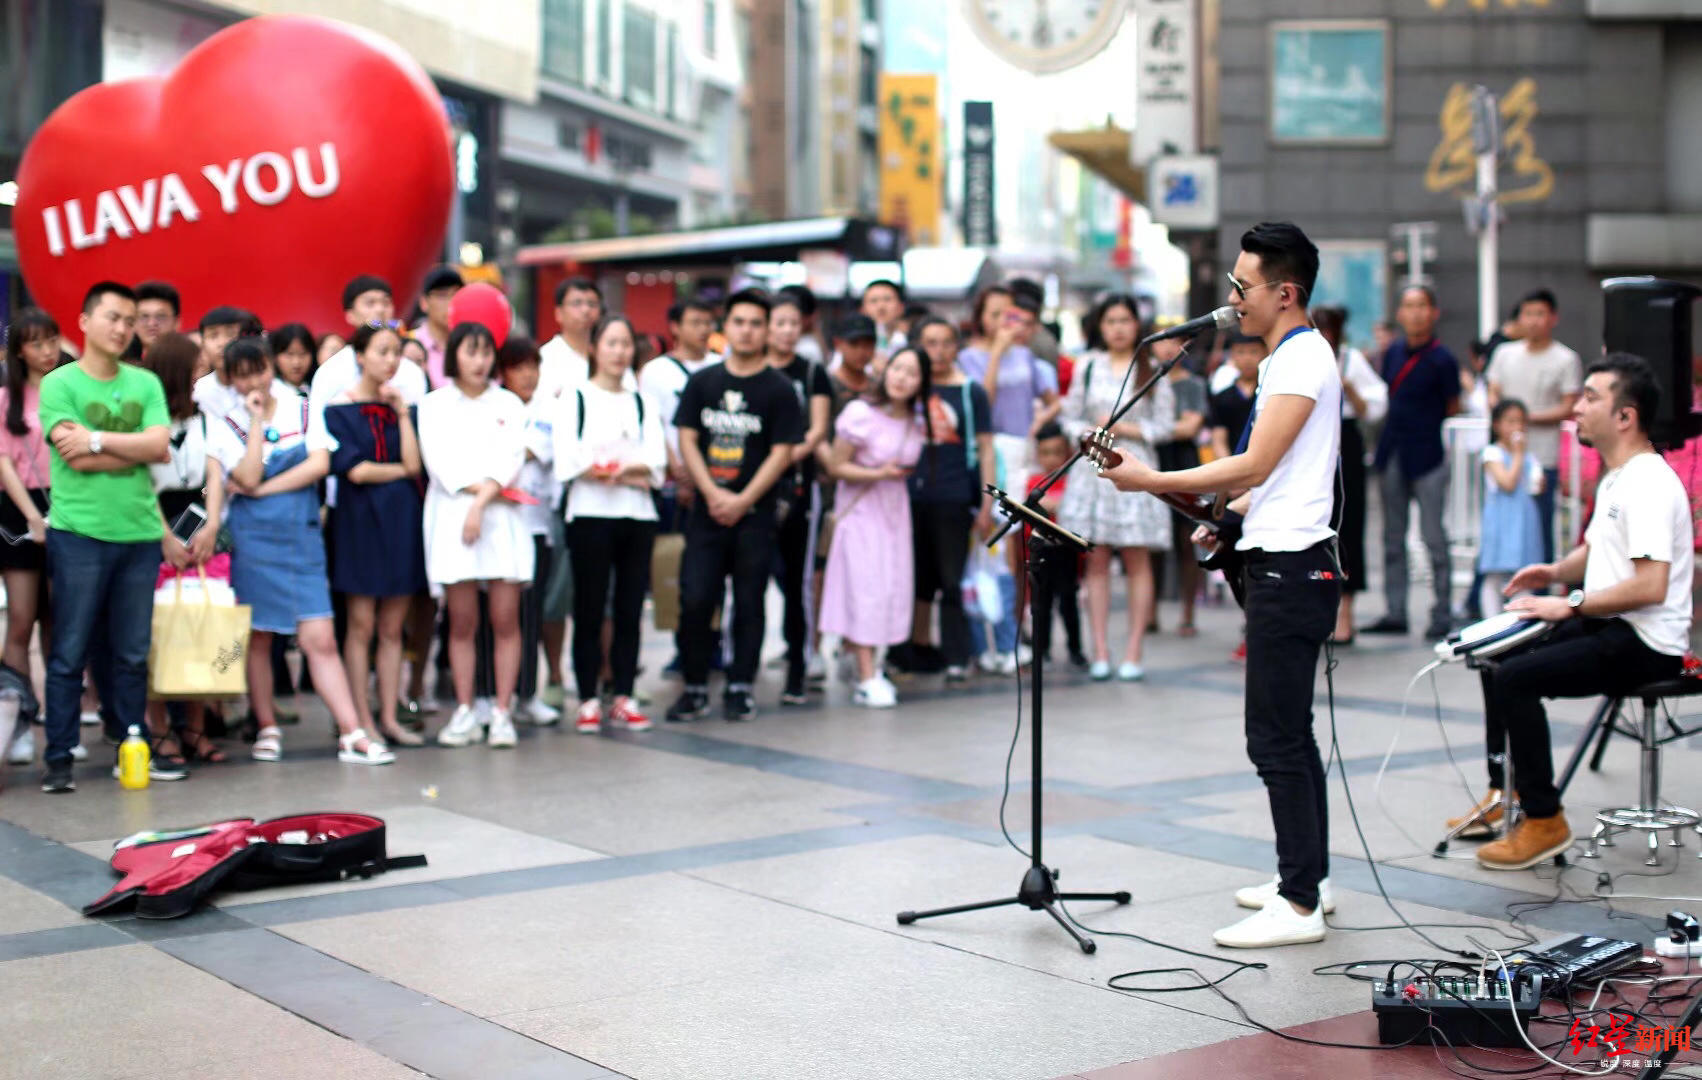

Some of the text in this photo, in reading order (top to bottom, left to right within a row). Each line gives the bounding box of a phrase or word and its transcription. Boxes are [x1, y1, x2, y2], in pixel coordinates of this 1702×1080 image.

[42, 141, 340, 257] I LAVA YOU
